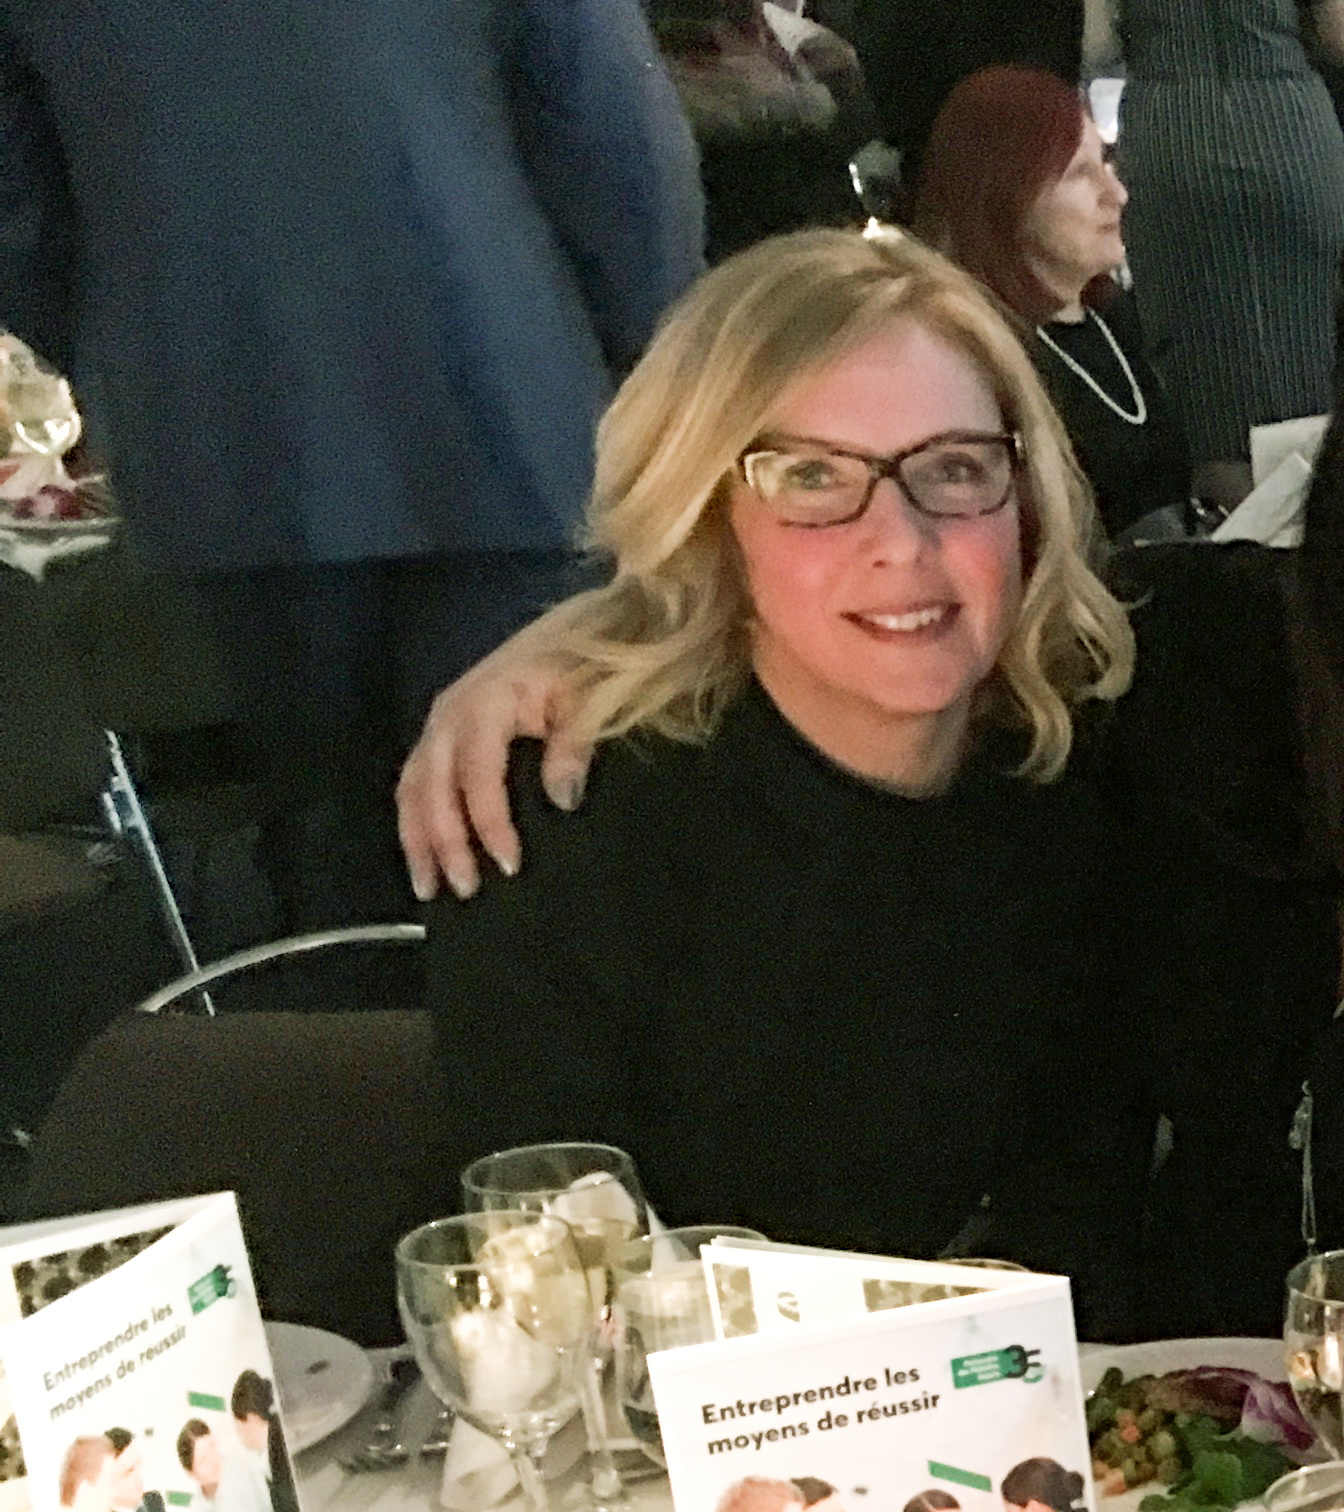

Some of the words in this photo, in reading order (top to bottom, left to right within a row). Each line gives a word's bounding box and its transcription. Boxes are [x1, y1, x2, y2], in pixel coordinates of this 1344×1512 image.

[43, 1319, 149, 1392] Entreprendre
[151, 1303, 173, 1325] les
[49, 1373, 112, 1421] moyens
[116, 1359, 136, 1380] de
[701, 1375, 878, 1425] Entreprendre
[884, 1367, 921, 1387] les
[707, 1421, 810, 1456] moyens
[817, 1411, 849, 1432] de
[856, 1390, 940, 1424] réussir
